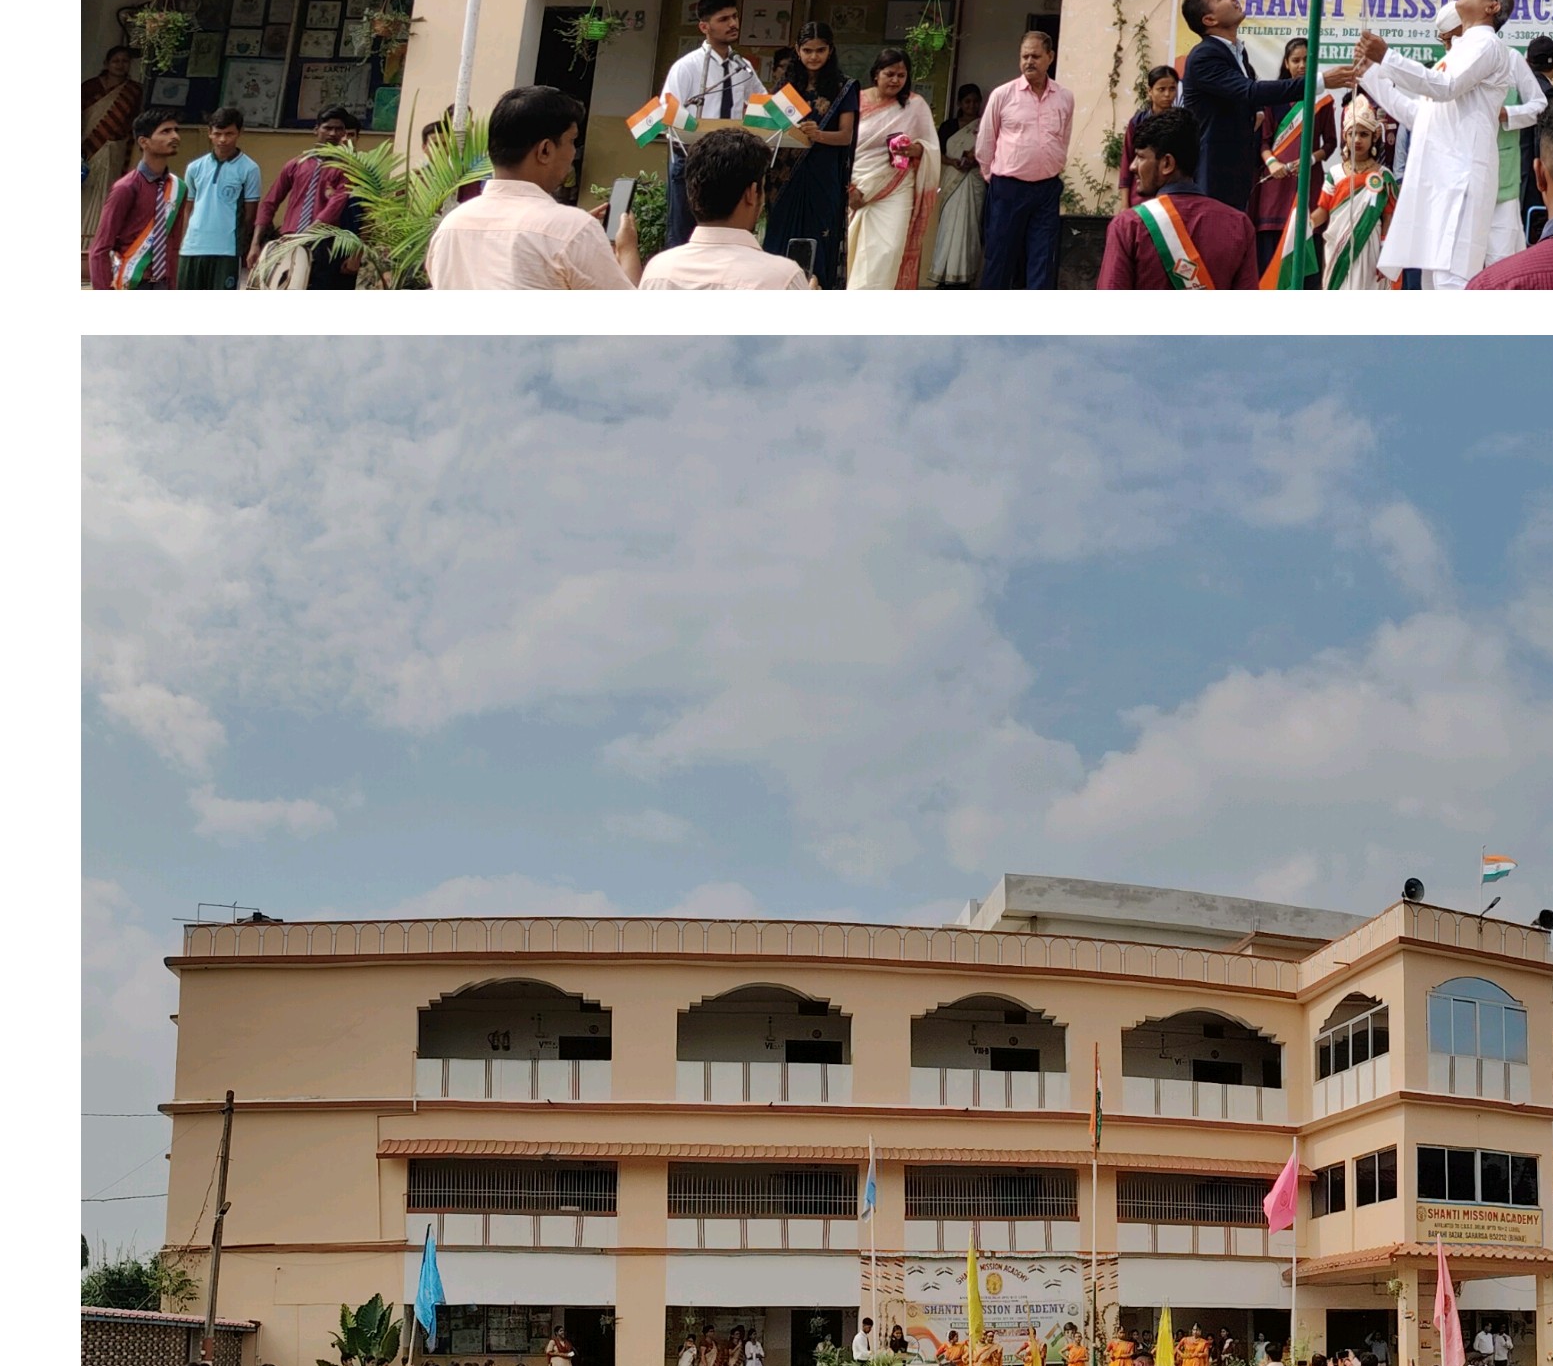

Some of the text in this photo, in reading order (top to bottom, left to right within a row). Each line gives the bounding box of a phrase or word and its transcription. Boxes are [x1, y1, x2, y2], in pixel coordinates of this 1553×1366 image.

[1379, 29, 1404, 38] UPTO
[1428, 1208, 1539, 1225] SHANTI MISSION ACADEMY
[980, 1262, 1003, 1271] MISSION
[1003, 1264, 1030, 1283] ACADEMY
[924, 1303, 1065, 1315] SHANTI SSION ACADEMY
